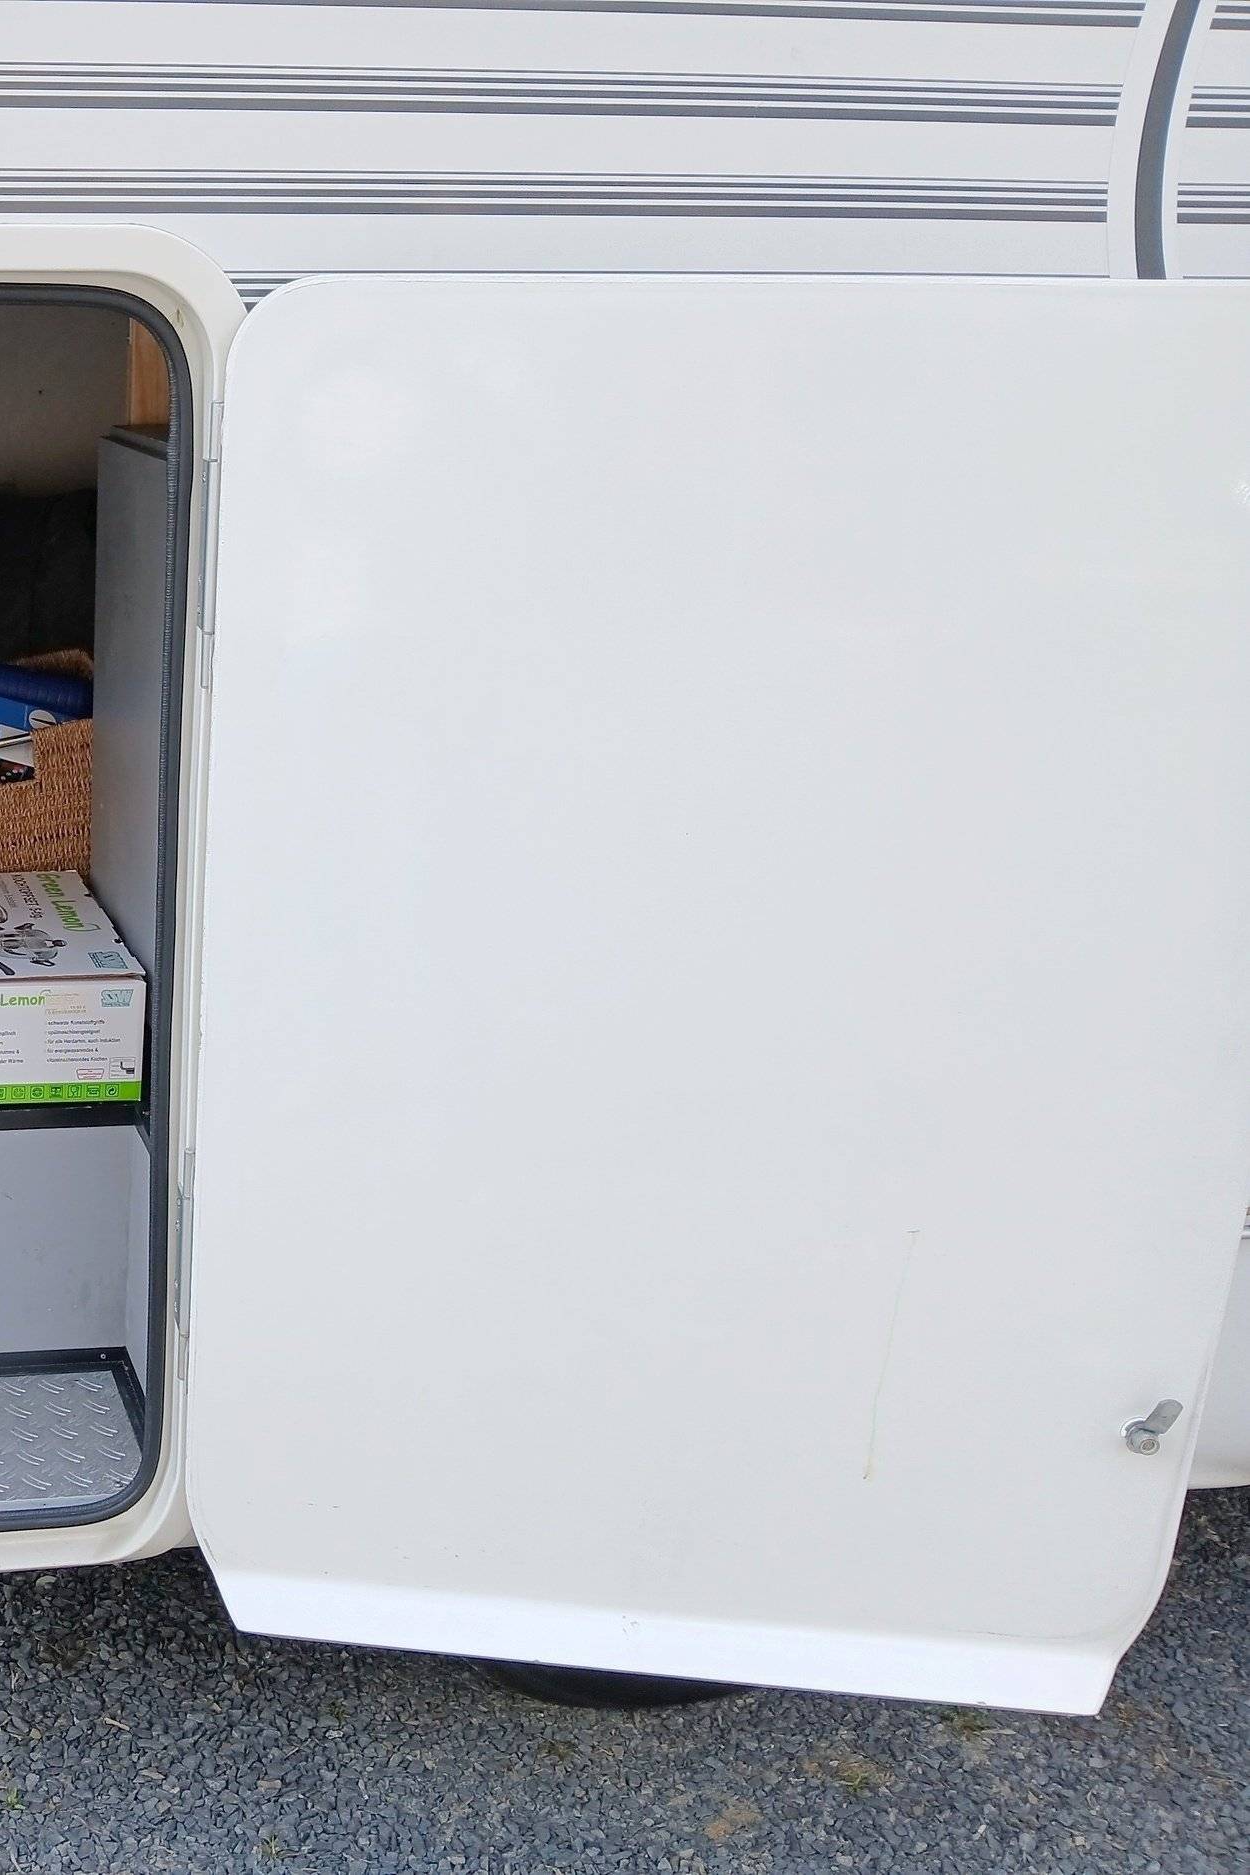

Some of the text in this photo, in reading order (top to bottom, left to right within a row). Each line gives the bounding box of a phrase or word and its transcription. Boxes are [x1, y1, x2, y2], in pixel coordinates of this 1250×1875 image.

[36, 873, 85, 928] Green Lemon
[0, 992, 46, 1007] Lemon
